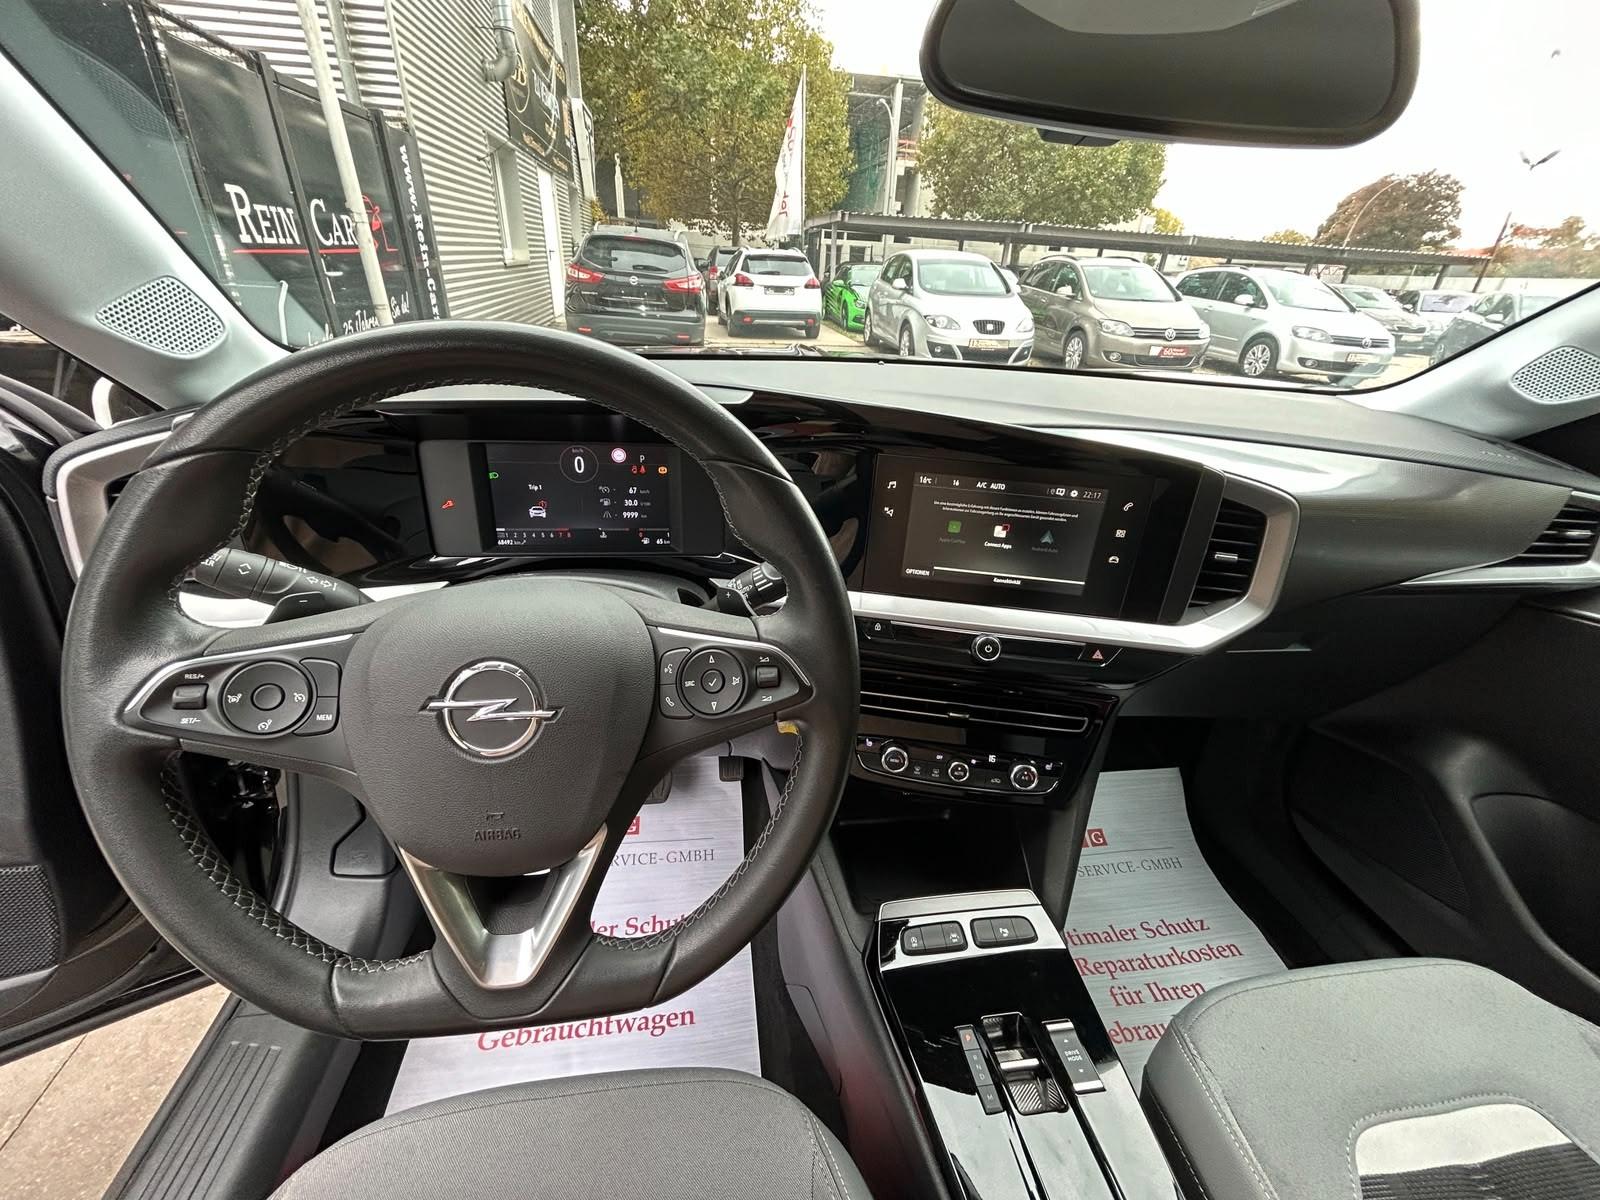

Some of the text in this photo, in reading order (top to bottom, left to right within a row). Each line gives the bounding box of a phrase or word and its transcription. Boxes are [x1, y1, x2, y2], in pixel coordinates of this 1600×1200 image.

[224, 183, 301, 245] REIN
[574, 455, 585, 474] 0
[628, 486, 638, 494] 67
[990, 483, 1006, 491] AUTO
[1083, 491, 1102, 499] 22:17
[624, 499, 639, 507] 30.0
[622, 511, 639, 519] 9999
[474, 828, 521, 841] AIRBAG
[1090, 831, 1105, 844] G
[611, 848, 715, 867] RVICE-GMBH
[1077, 857, 1183, 878] SERVICE-GMBH
[1065, 917, 1211, 947] timaler Schutz
[1074, 942, 1245, 980] Reparaturkosten
[1109, 980, 1207, 1007] für Ihren
[1108, 1020, 1168, 1045] ebrau
